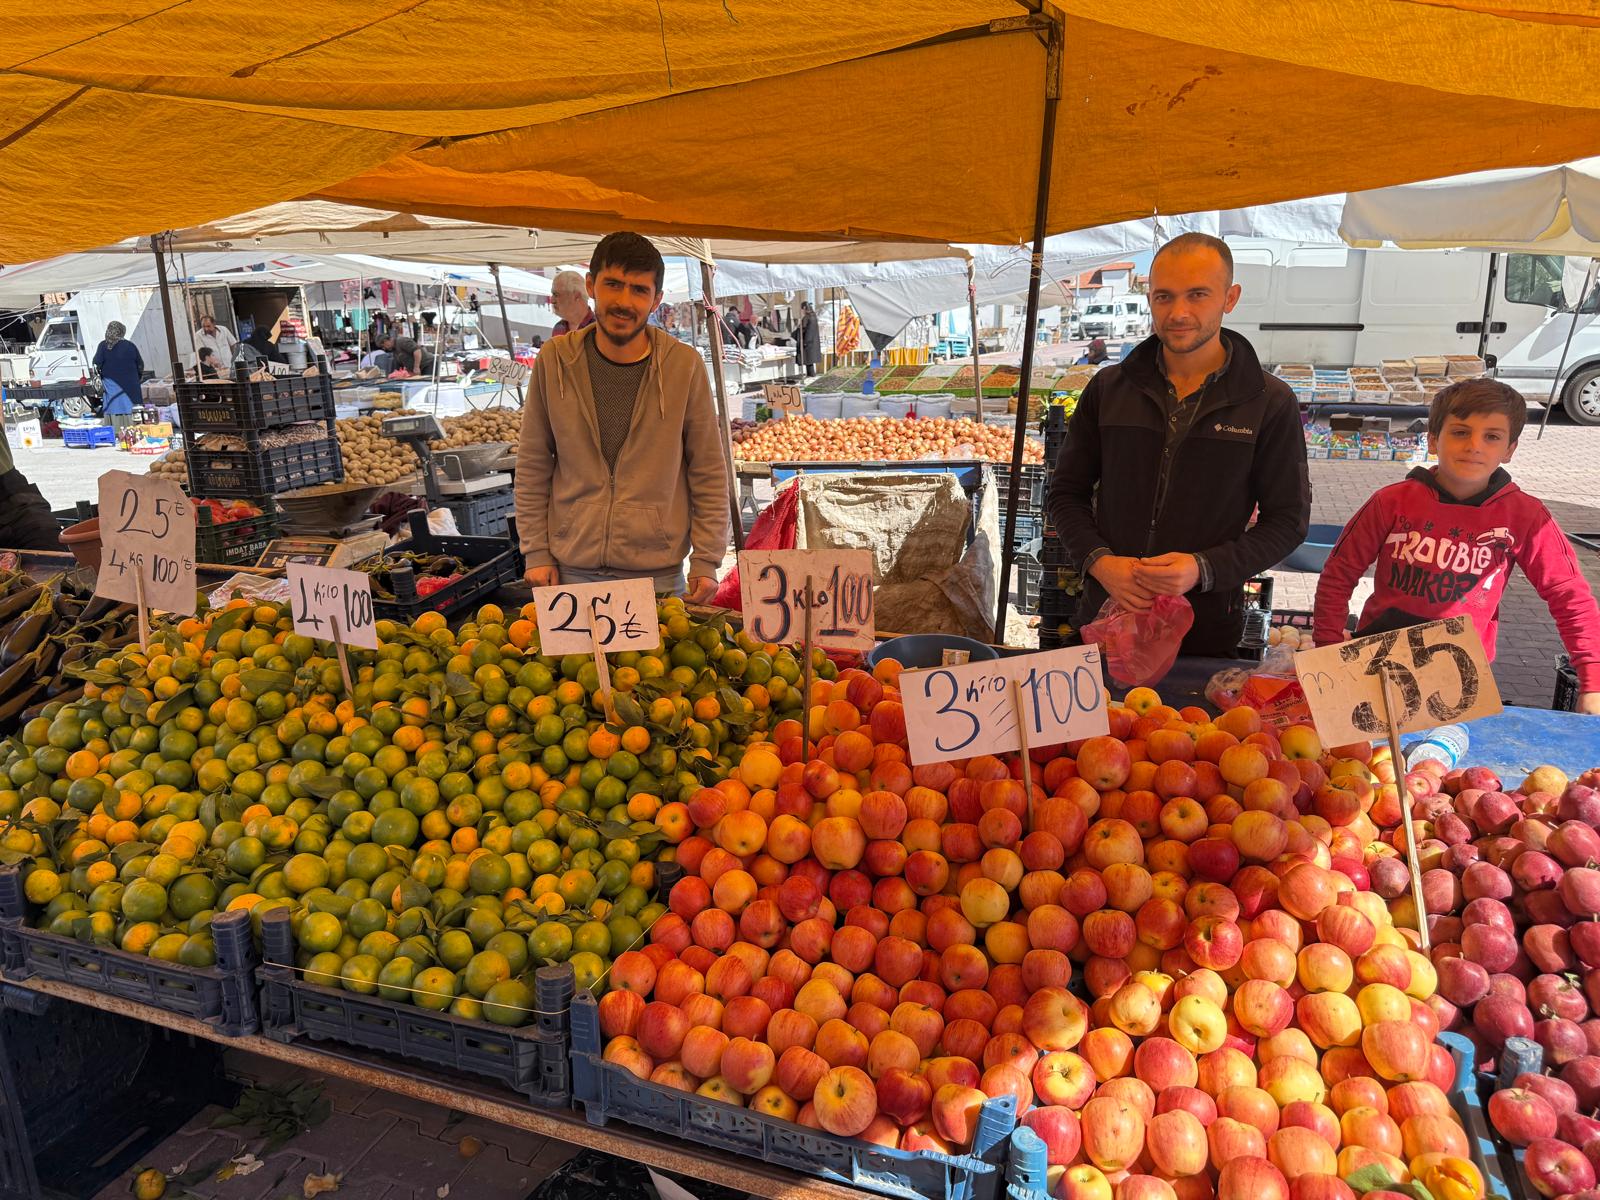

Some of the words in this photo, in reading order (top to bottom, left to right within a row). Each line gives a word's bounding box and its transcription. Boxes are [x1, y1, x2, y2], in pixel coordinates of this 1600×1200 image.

[764, 384, 776, 406] 4
[781, 385, 802, 407] 50
[1223, 424, 1253, 435] Columbia
[108, 549, 128, 576] 4
[129, 551, 144, 567] KG
[297, 577, 324, 632] 4
[343, 583, 373, 633] 100
[754, 564, 791, 643] 3
[819, 565, 873, 637] 100
[1339, 615, 1479, 734] 35
[925, 670, 981, 752] 3
[1020, 665, 1101, 733] 100
